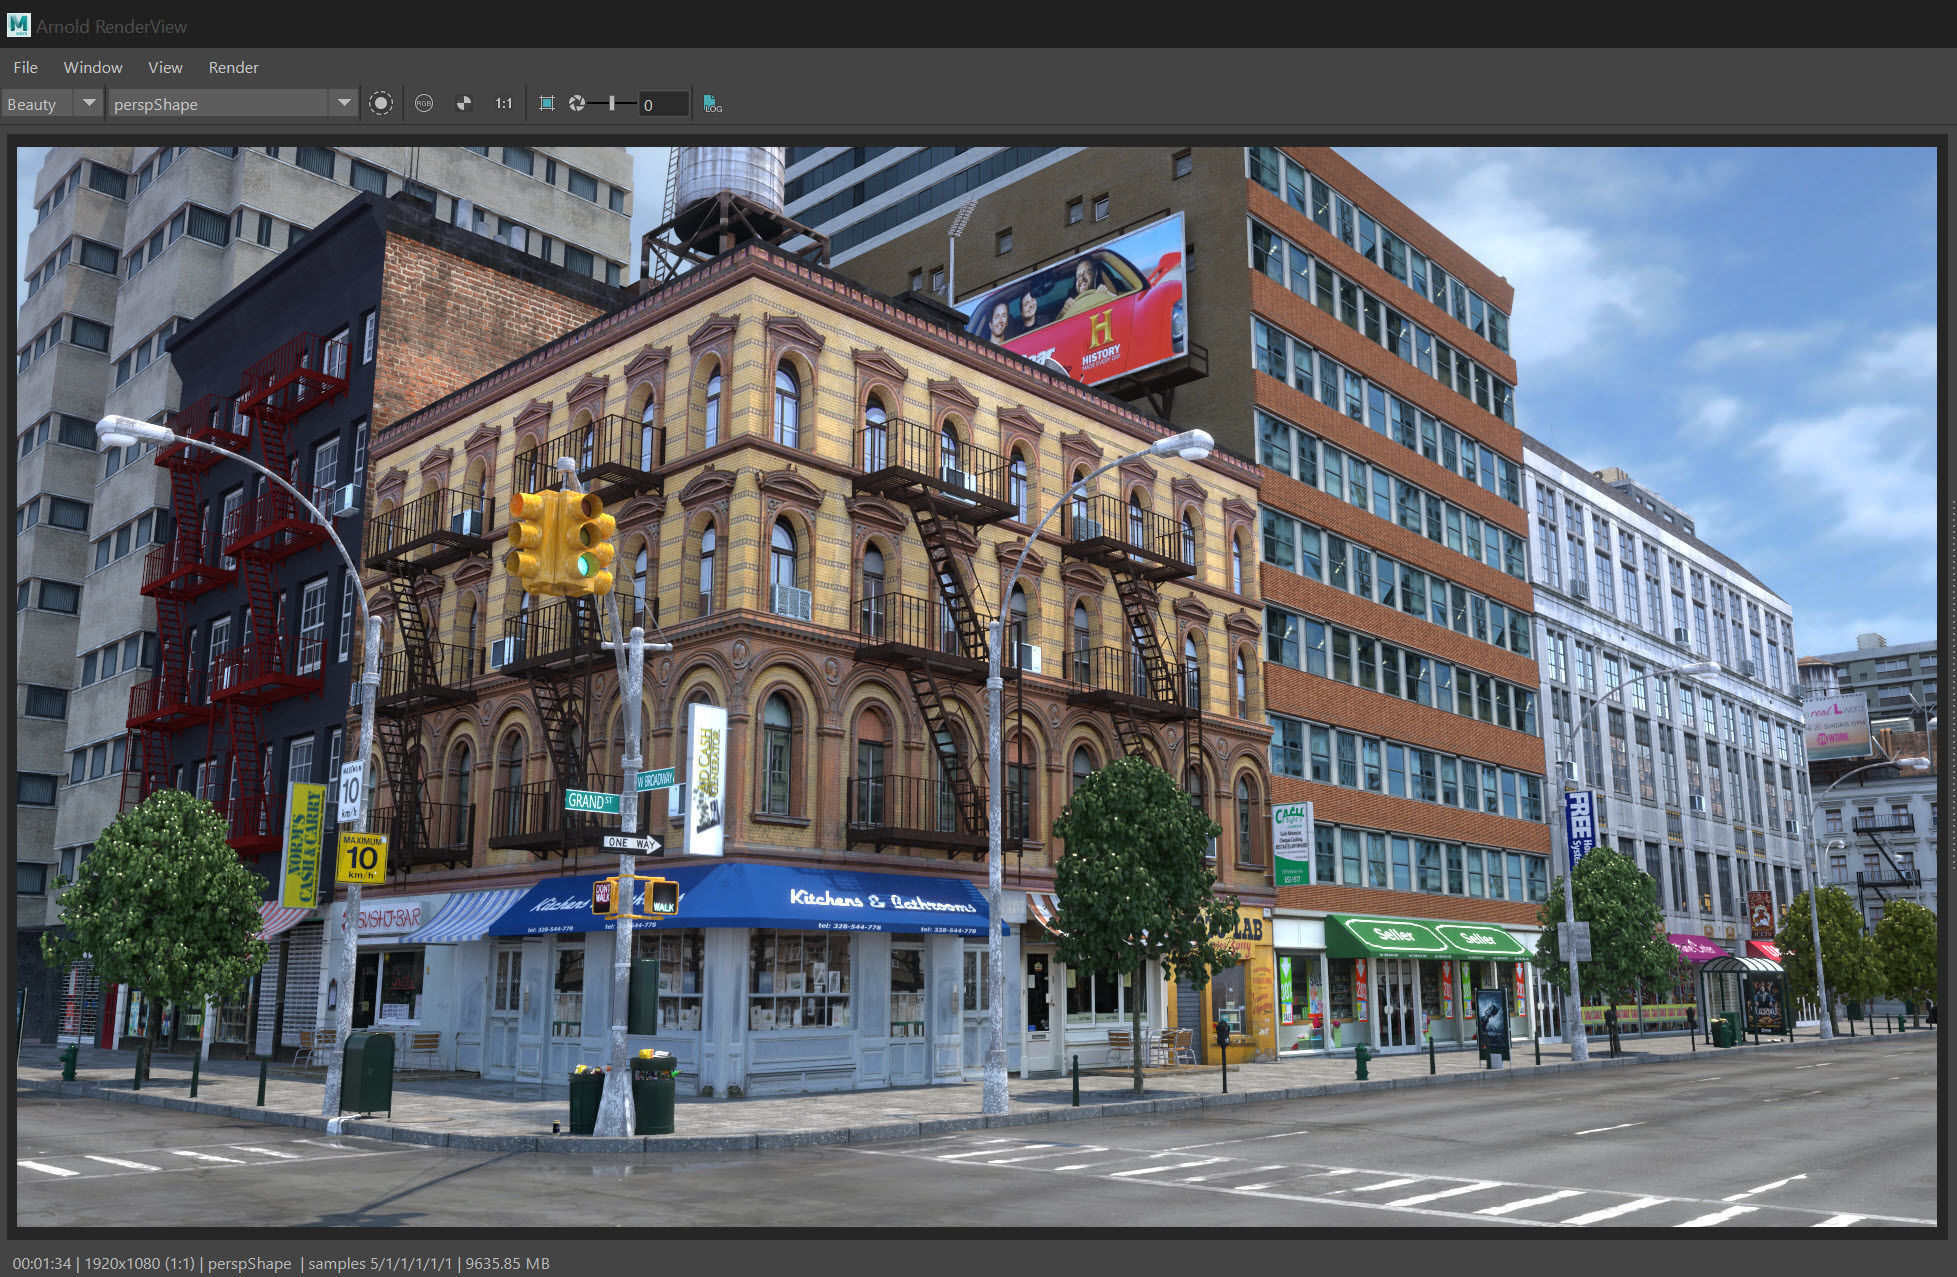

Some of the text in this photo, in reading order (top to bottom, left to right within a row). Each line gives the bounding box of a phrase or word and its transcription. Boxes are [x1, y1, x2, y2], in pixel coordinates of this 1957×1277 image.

[36, 19, 188, 34] Arnold RenderView
[14, 61, 39, 74] File
[64, 61, 123, 74] Window
[148, 61, 183, 74] View
[209, 61, 259, 74] Render
[8, 98, 56, 114] Beauty
[114, 98, 198, 115] perspShape
[495, 97, 513, 109] 1:1
[644, 100, 653, 111] 0
[705, 105, 723, 113] LOG
[1089, 309, 1114, 349] H
[1082, 344, 1121, 366] HISTORY
[1834, 704, 1843, 715] L
[699, 728, 712, 768] CASH
[709, 730, 720, 798] GENERATOR
[645, 772, 673, 788] BROADWAY
[342, 777, 360, 805] 10
[568, 792, 614, 810] GRAND ST
[304, 790, 322, 844] CARRY
[1570, 791, 1592, 839] FREE
[343, 836, 384, 847] MAXIMUM
[609, 838, 656, 850] ONE WAY
[347, 846, 378, 870] 10
[299, 857, 315, 903] CASH
[349, 872, 374, 880] km/h
[596, 893, 610, 903] WALK
[790, 888, 977, 913] Kitchens & Bathrooms
[653, 902, 675, 912] WALK
[833, 923, 882, 931] 328-544-778
[1233, 917, 1263, 941] LAB
[1373, 927, 1416, 943] Seller
[1459, 932, 1497, 946] Seller
[13, 1256, 550, 1273] 00:01:34 1920x1080 (1:1) perspShape samples 5/1/1/1/1/1 9635.85 MB
